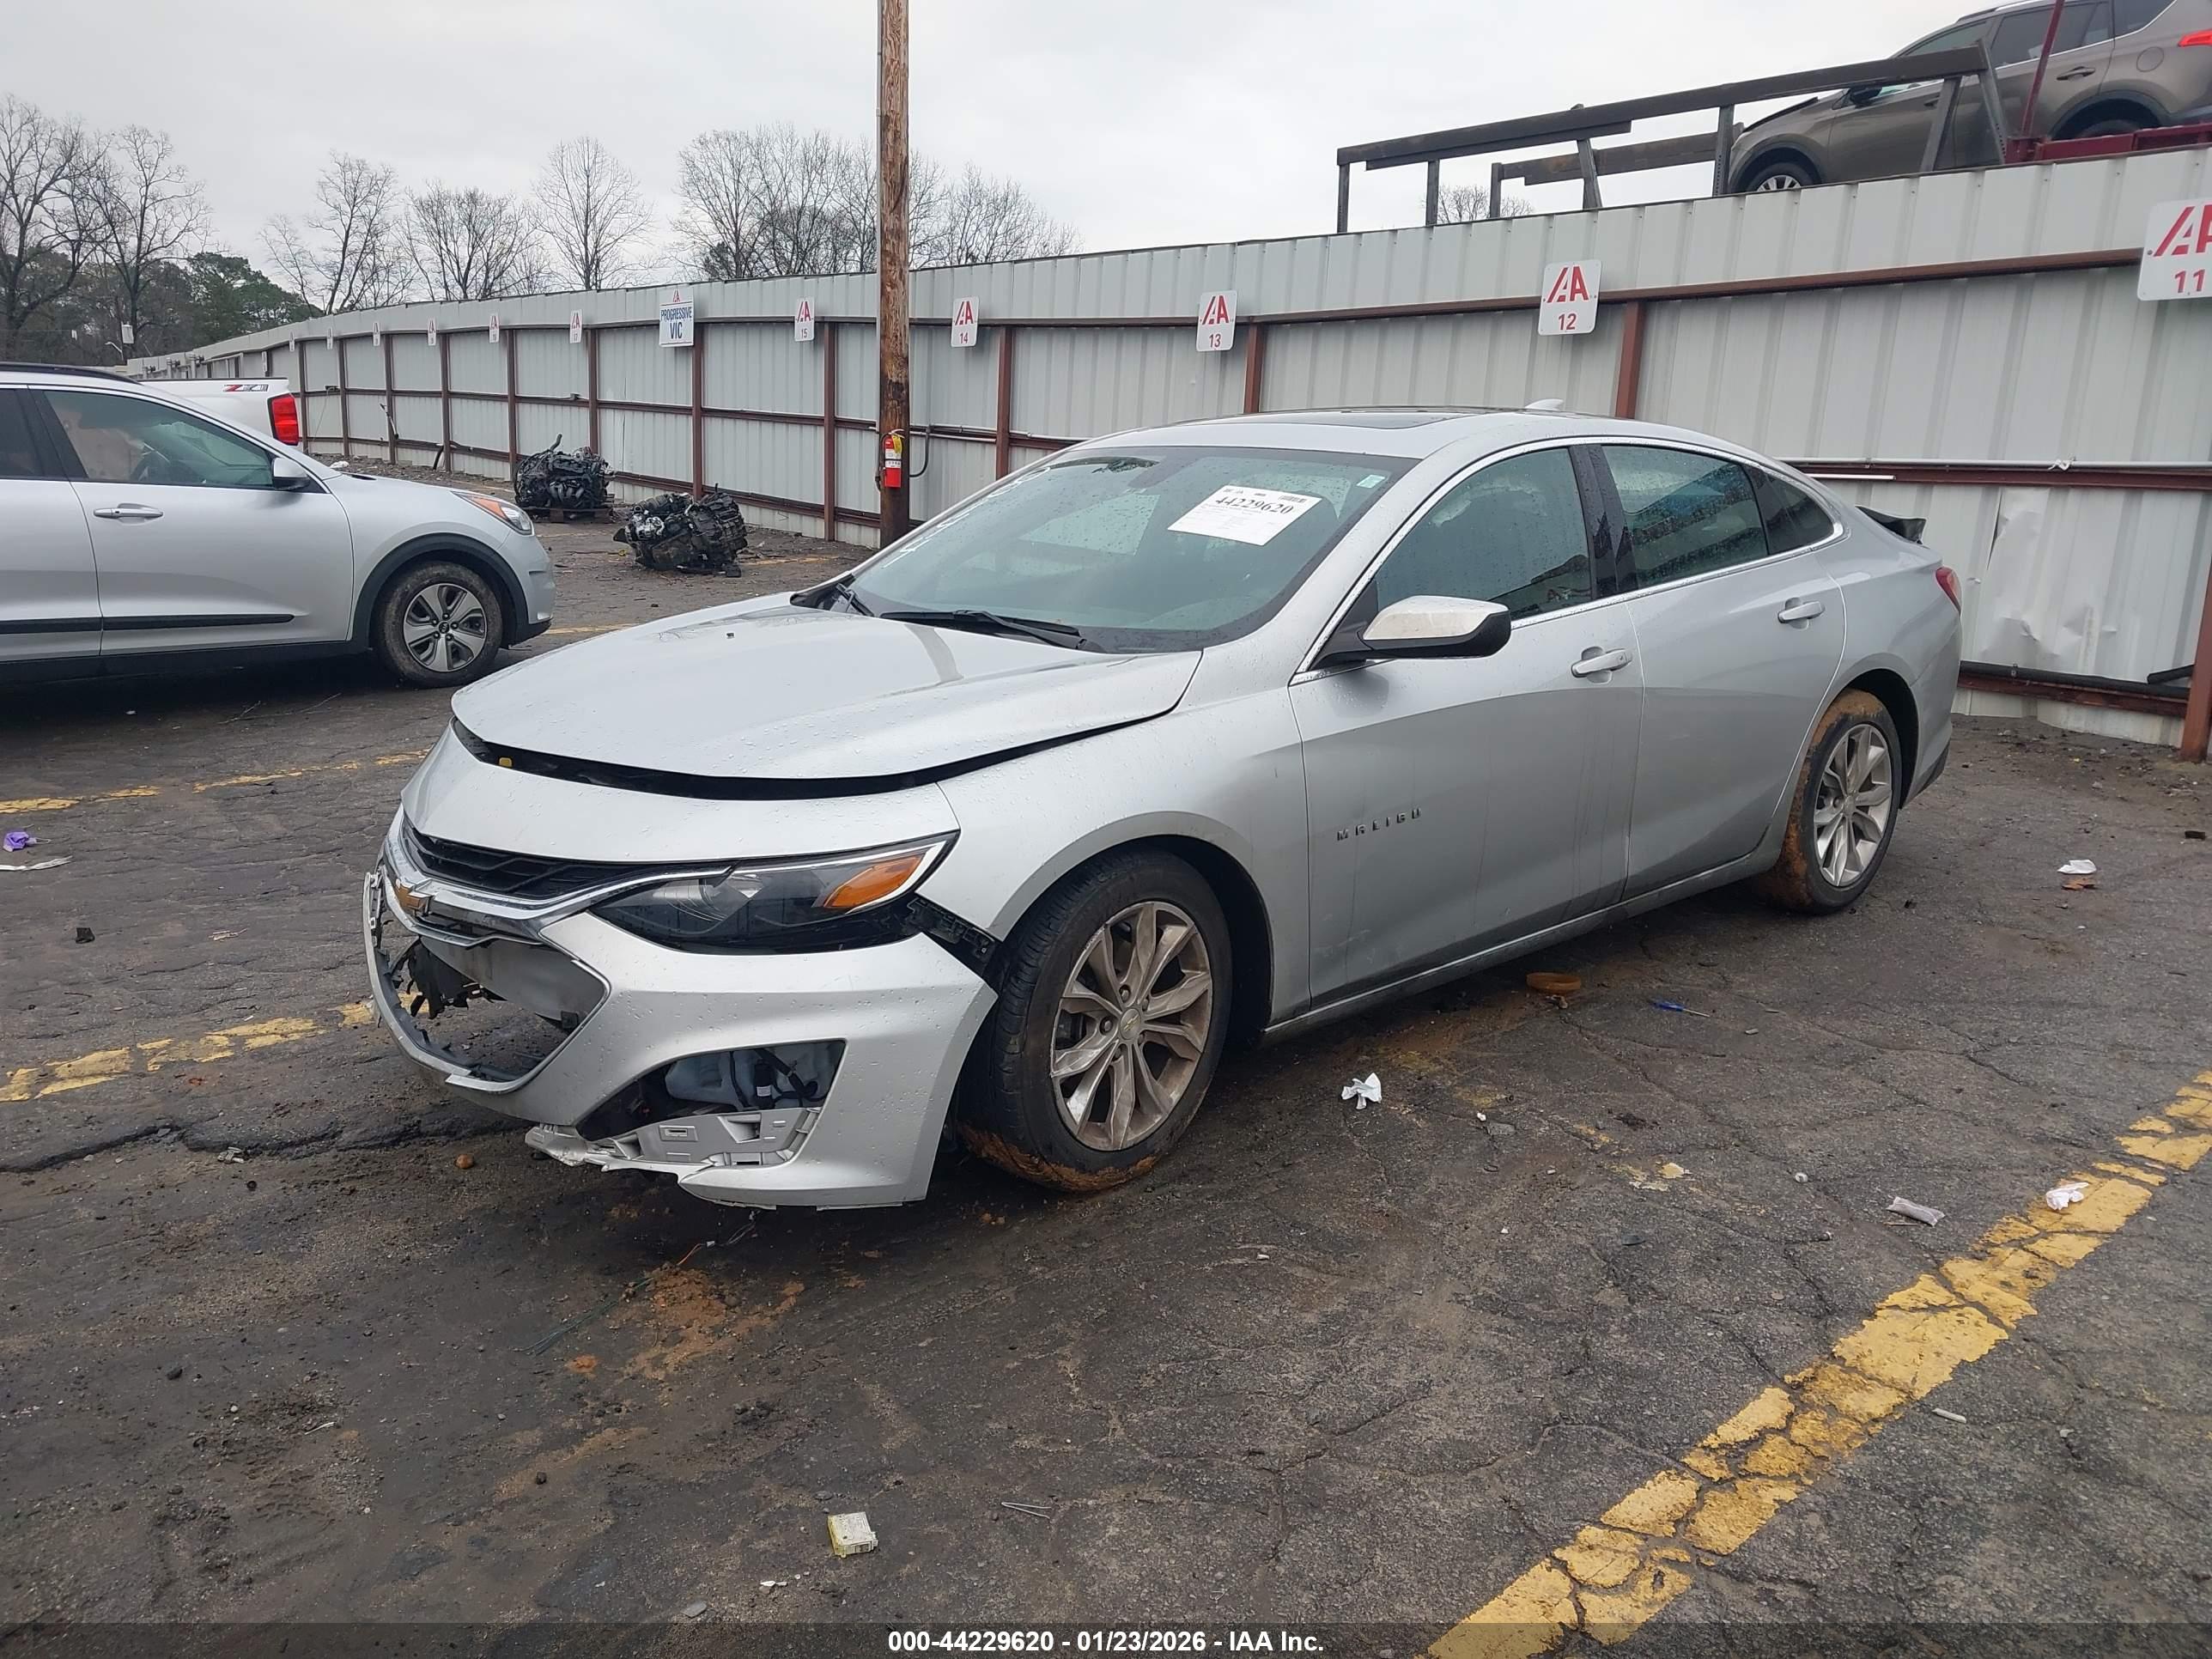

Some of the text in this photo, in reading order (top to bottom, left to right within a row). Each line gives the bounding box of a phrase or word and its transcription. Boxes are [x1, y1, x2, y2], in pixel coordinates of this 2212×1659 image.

[2174, 269, 2205, 294] 11
[660, 306, 692, 321] PROGRESSIVE
[1559, 313, 1577, 331] 12
[670, 322, 683, 339] VIC
[960, 332, 969, 344] 14
[1209, 333, 1221, 348] 13
[1216, 496, 1294, 514] 44229620
[1336, 807, 1422, 842] MALIBU
